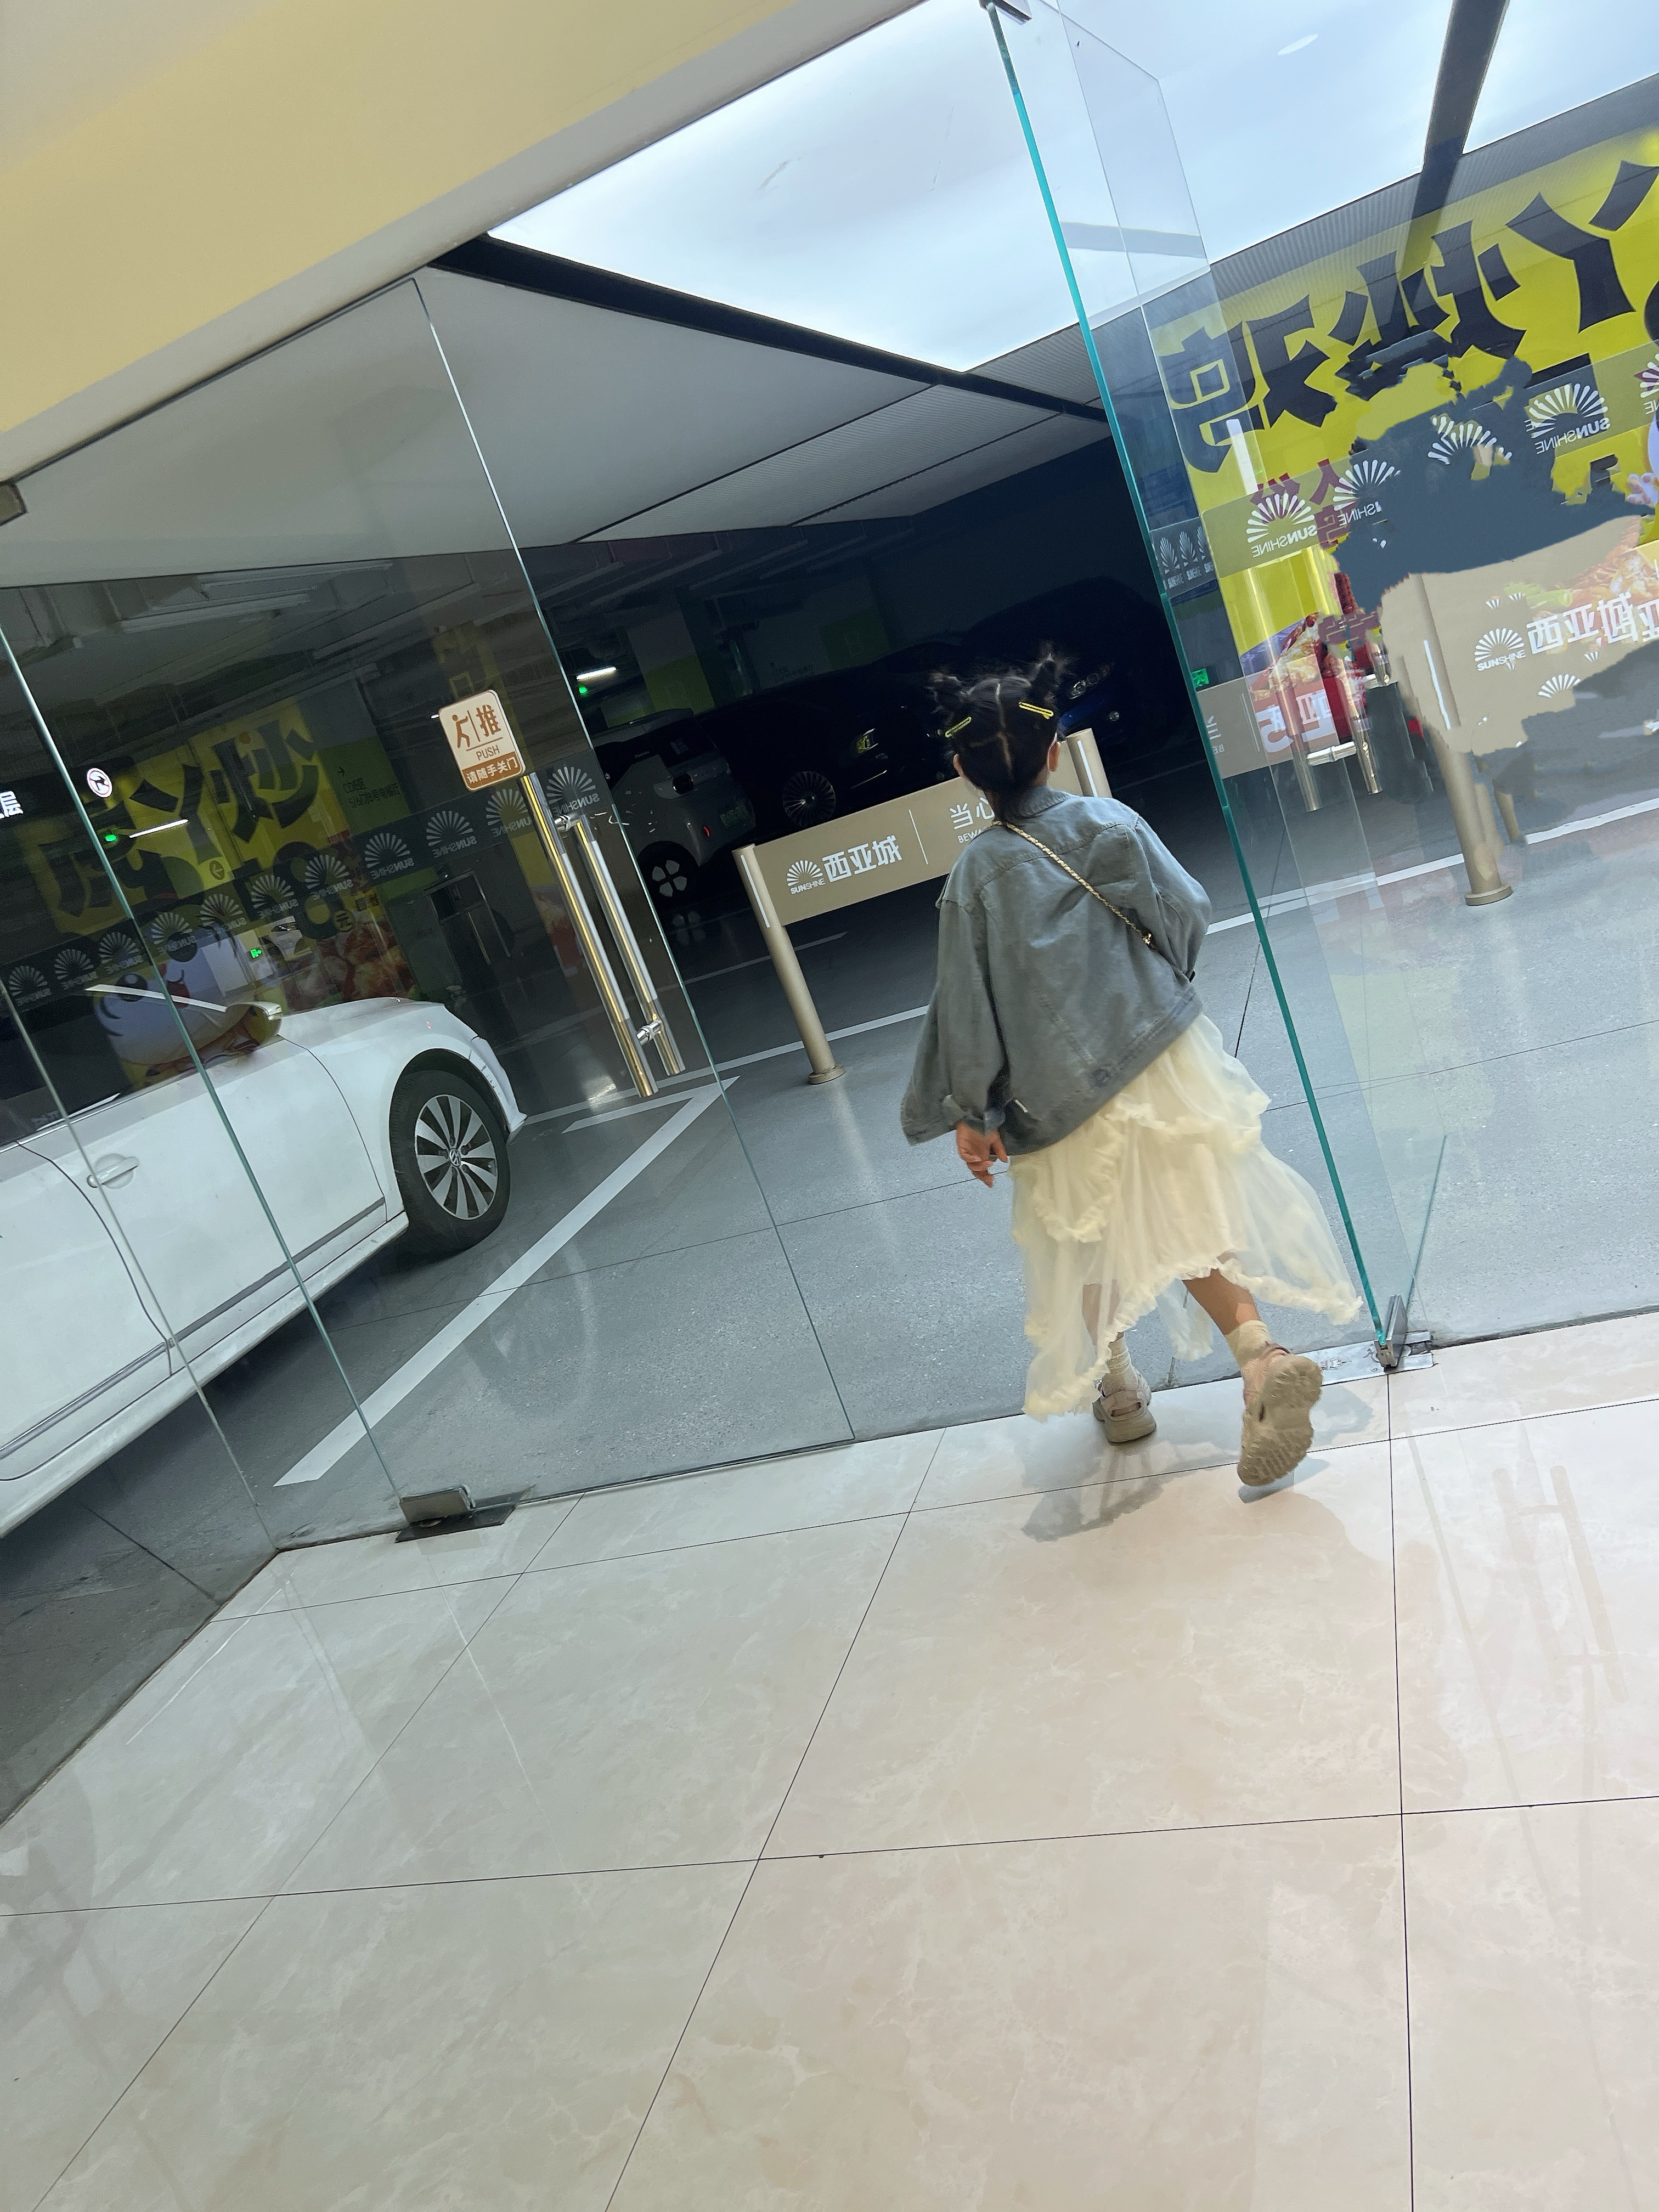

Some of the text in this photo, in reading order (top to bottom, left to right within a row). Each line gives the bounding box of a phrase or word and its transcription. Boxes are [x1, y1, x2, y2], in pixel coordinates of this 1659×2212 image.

[1477, 649, 1527, 672] SUNSHINE
[476, 704, 501, 737] 推
[475, 744, 500, 761] PUSH
[466, 756, 518, 785] 请随手关门
[0, 790, 24, 820] 层
[822, 834, 902, 883] 西亚城
[790, 877, 826, 895] SUNSHINE
